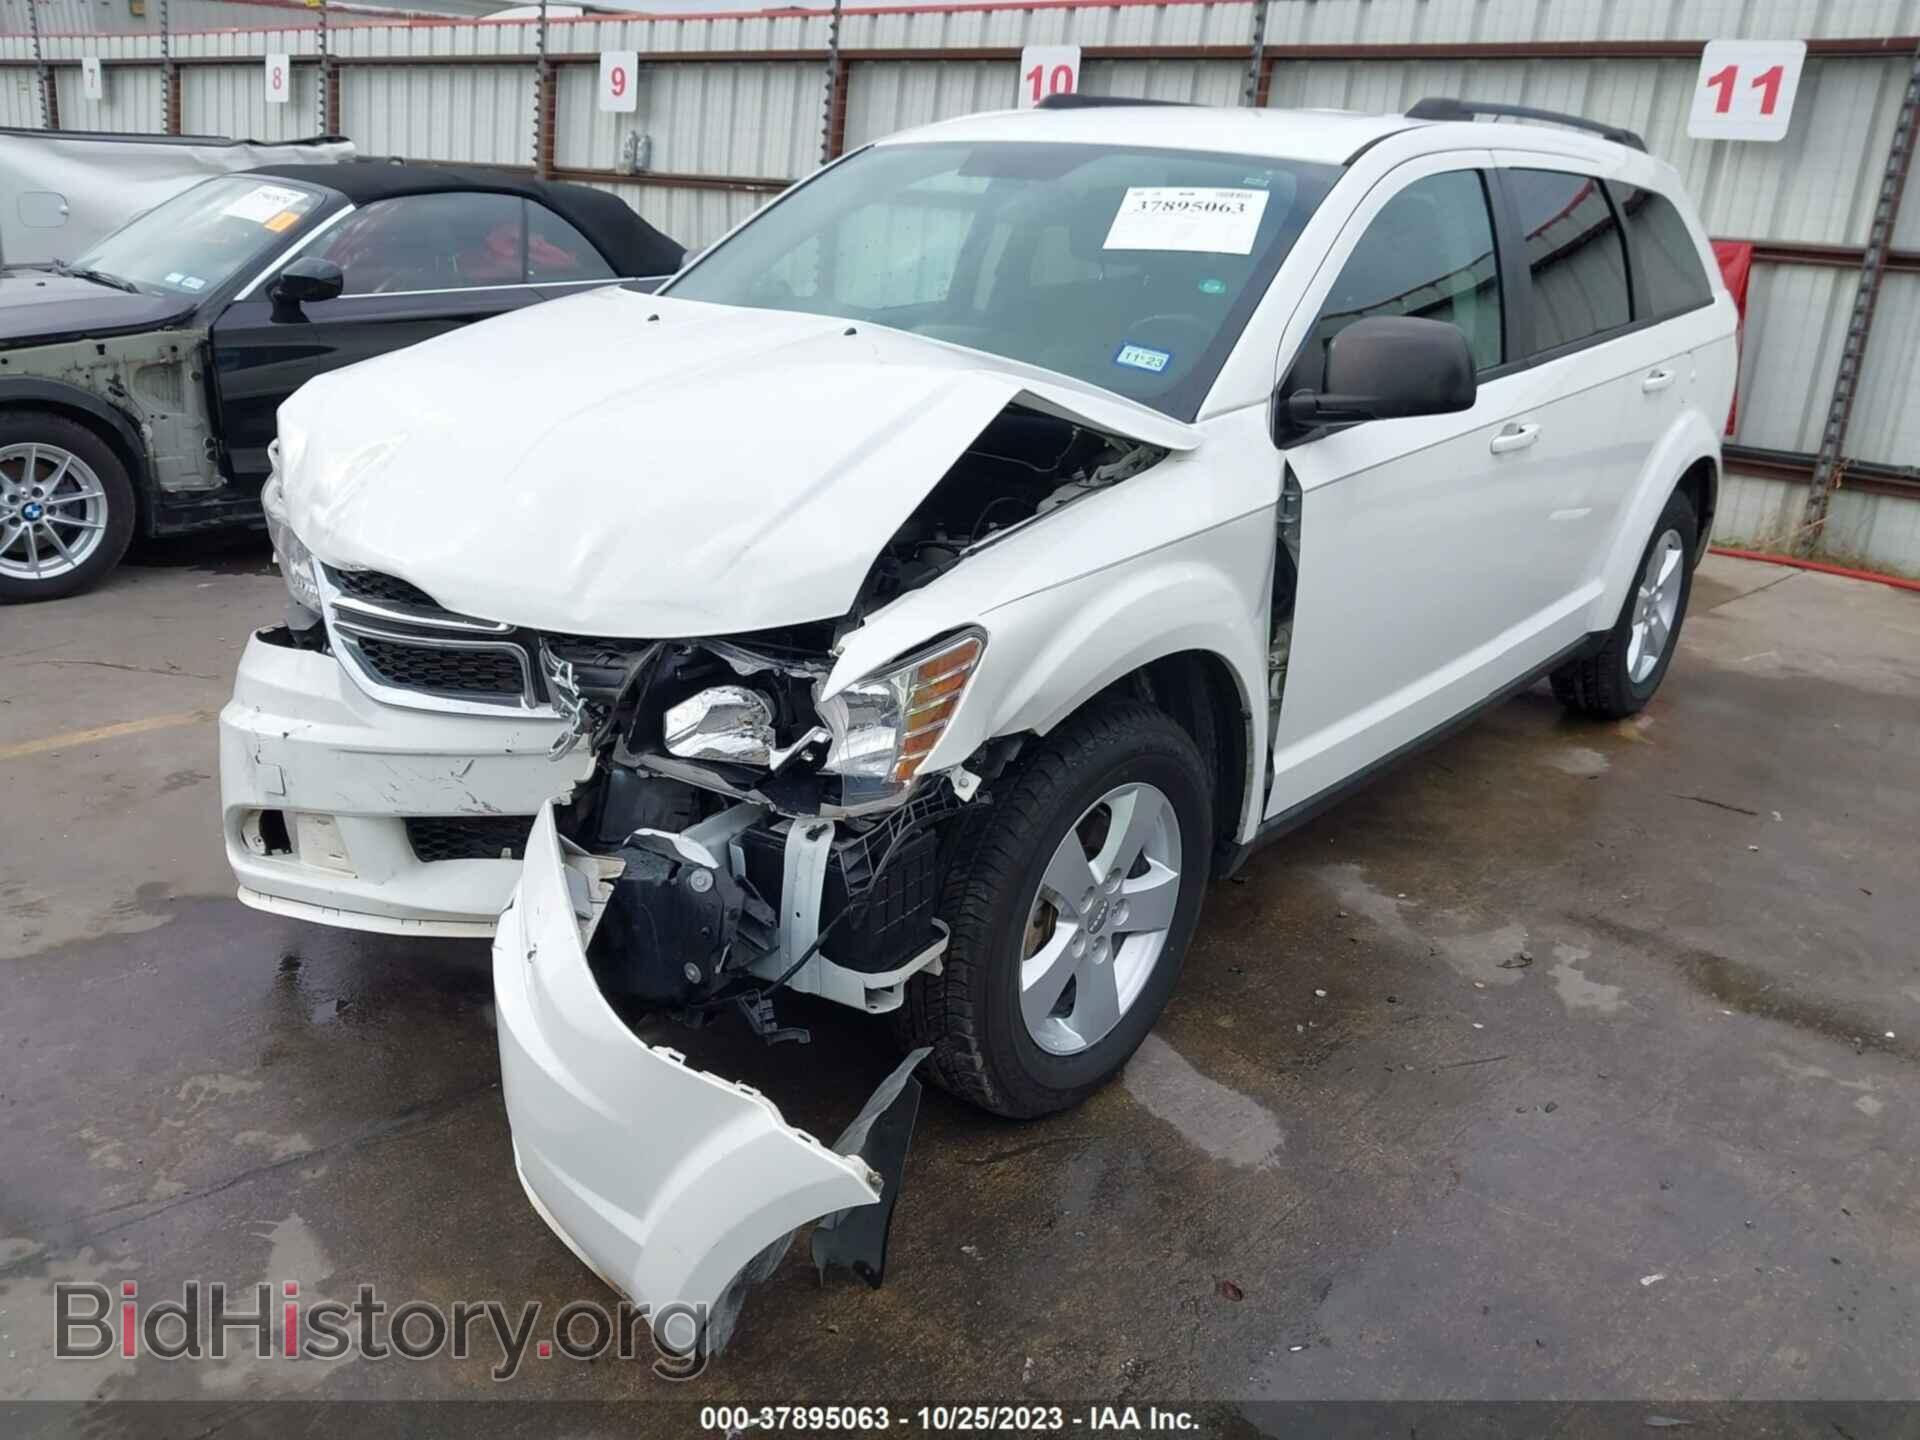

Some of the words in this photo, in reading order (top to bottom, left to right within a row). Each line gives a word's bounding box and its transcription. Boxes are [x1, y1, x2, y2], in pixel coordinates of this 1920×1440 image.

[273, 66, 283, 90] 8
[611, 67, 625, 96] 9
[1026, 64, 1073, 102] 10
[1707, 64, 1784, 115] 11
[1134, 200, 1246, 214] 37895063
